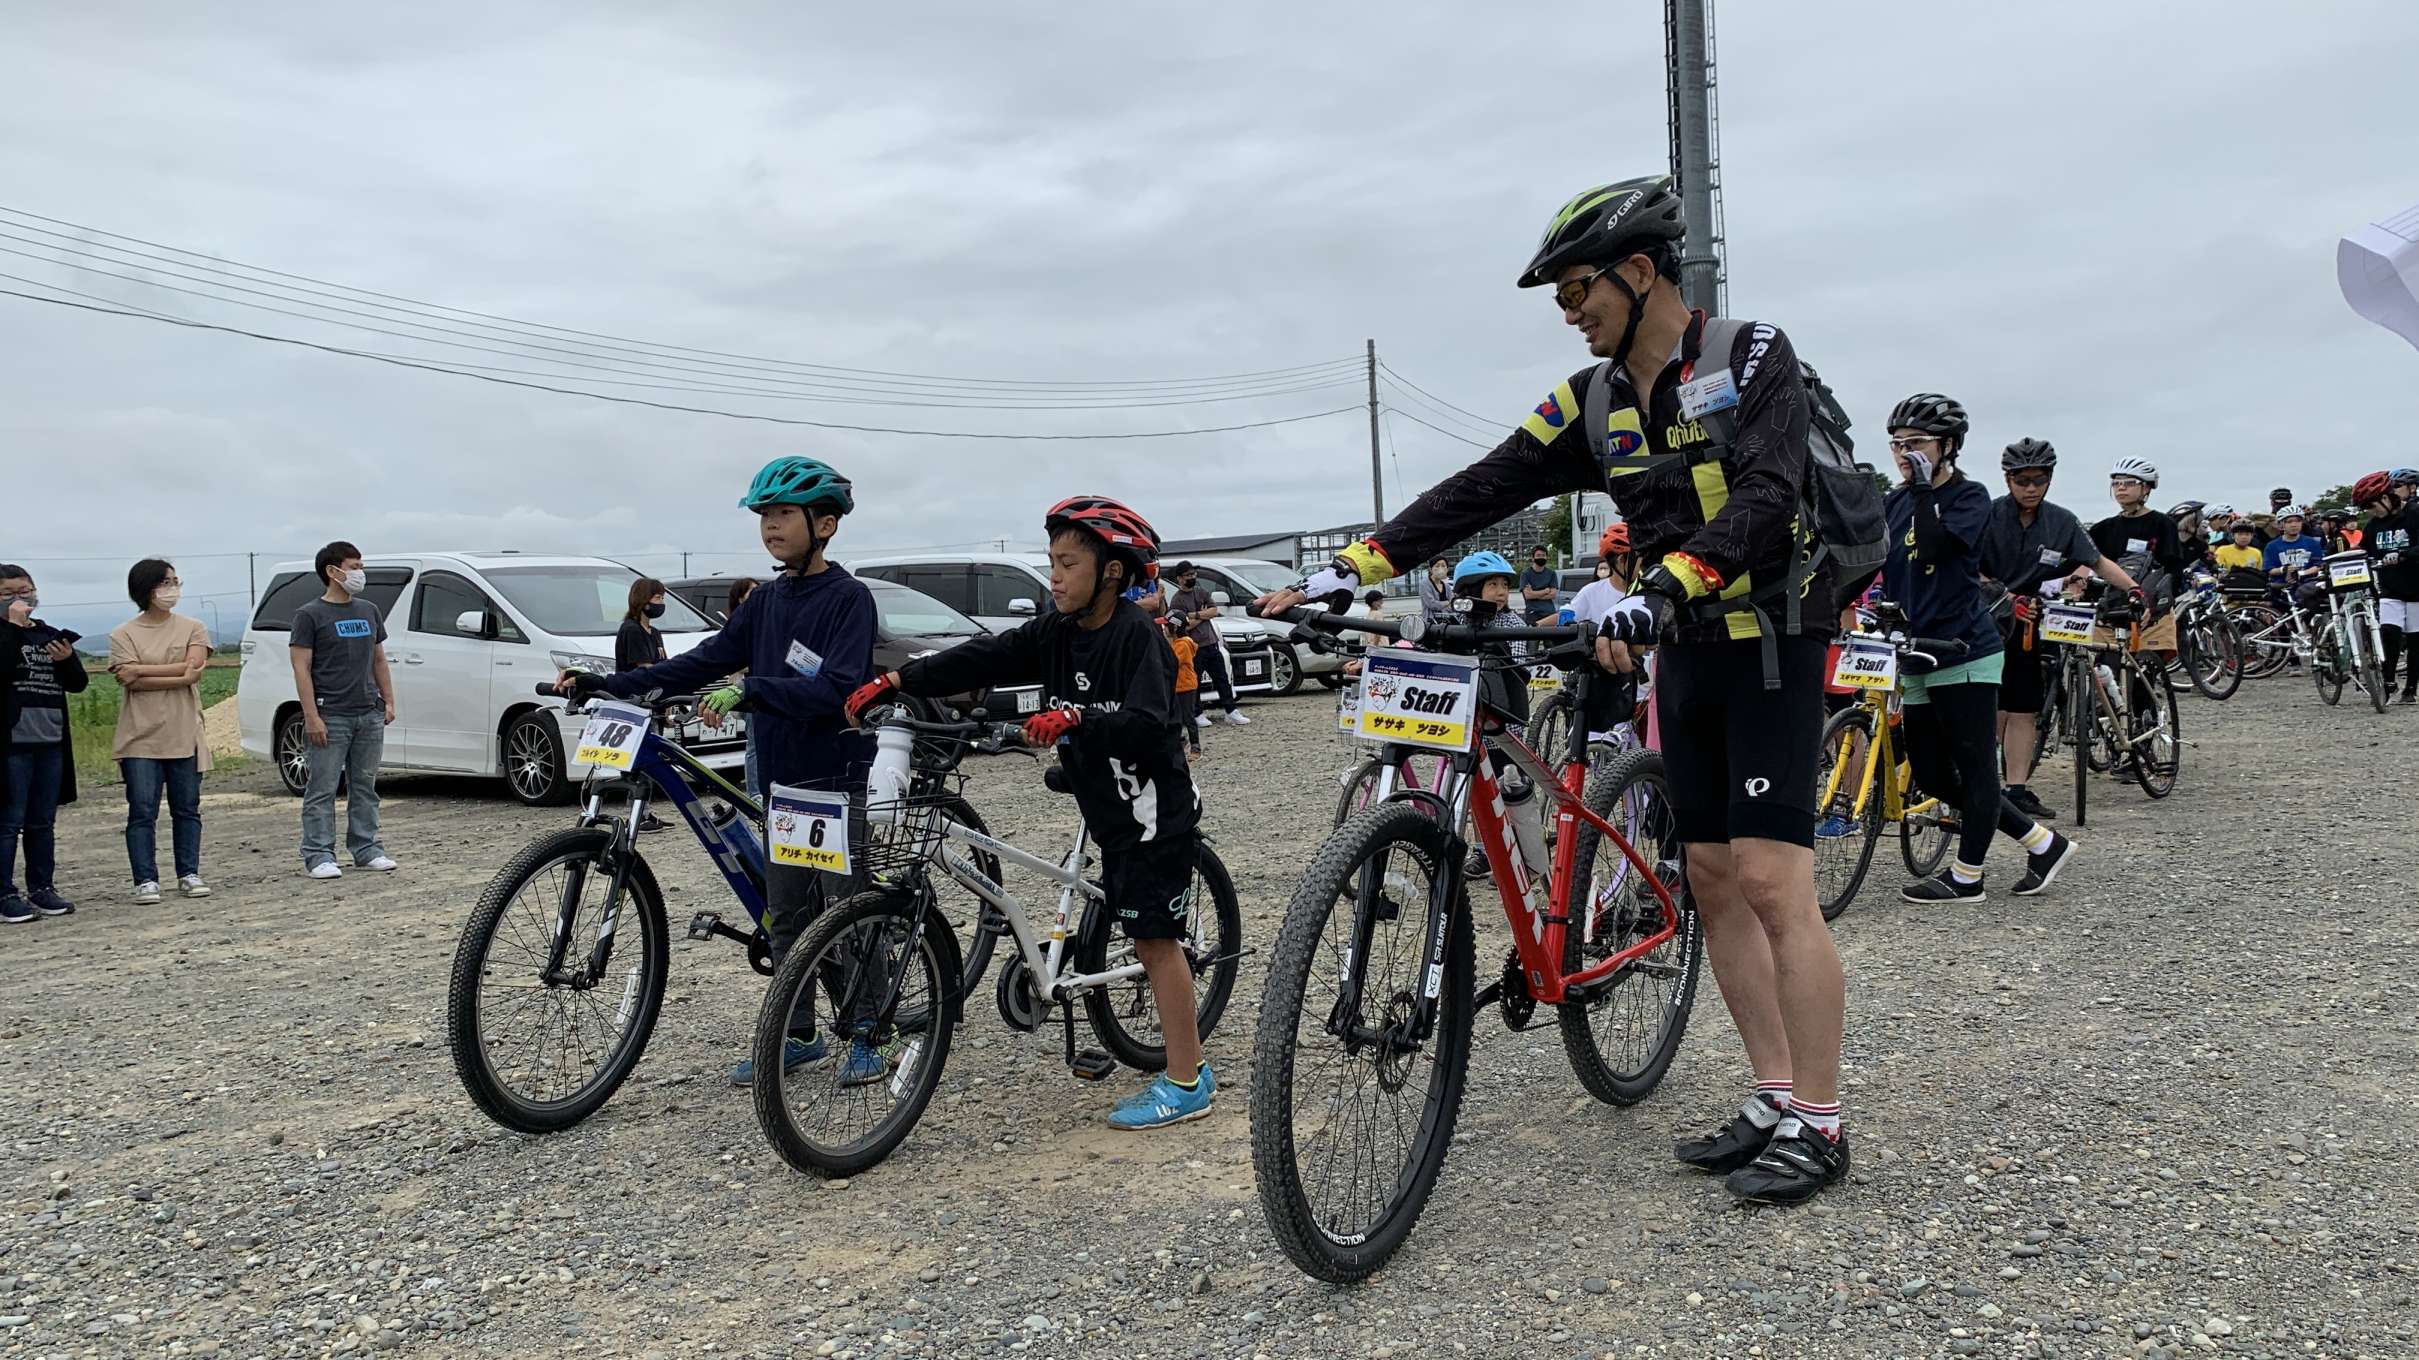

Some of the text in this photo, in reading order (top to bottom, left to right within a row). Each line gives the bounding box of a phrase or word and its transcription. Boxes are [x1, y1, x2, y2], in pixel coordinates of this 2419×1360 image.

[1617, 190, 1644, 217] GIRO
[337, 621, 369, 634] CHUMS
[2063, 620, 2090, 632] Staff
[1535, 665, 1553, 679] 22
[1855, 657, 1888, 672] Staff
[1400, 685, 1461, 716] Staff
[598, 722, 633, 749] 48
[1373, 716, 1406, 732] ササキ
[1416, 721, 1451, 737] ツヨシ
[808, 818, 827, 849] 6
[780, 847, 836, 864] アリチ カイセイ
